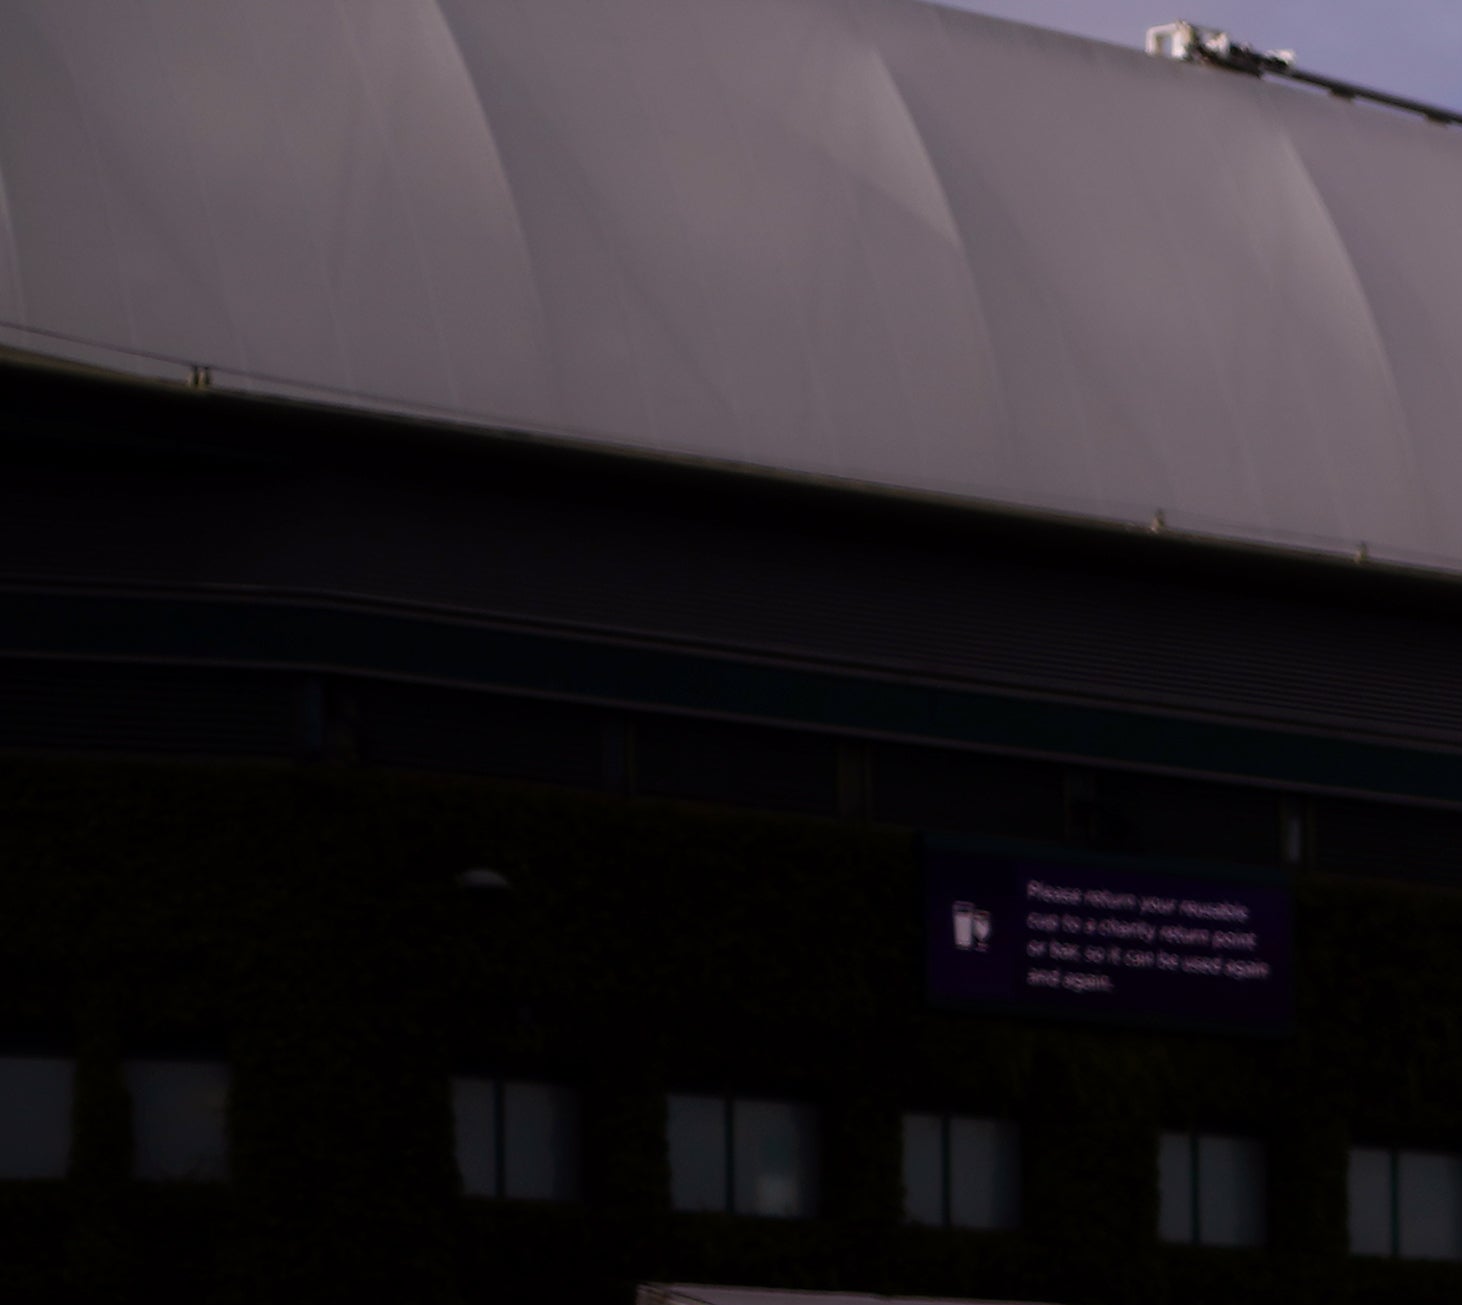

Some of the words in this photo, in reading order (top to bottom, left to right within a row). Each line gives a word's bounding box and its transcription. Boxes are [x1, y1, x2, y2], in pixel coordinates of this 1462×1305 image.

[1026, 879, 1082, 905] Please
[1084, 888, 1136, 910] return
[1138, 896, 1177, 916] your
[1179, 898, 1249, 923] reusable
[1061, 914, 1082, 934] to
[1098, 917, 1155, 944] charity
[1159, 924, 1210, 946] return
[1211, 929, 1257, 951] point
[1026, 938, 1047, 957] or
[1084, 945, 1105, 964] so
[1123, 949, 1155, 968] can
[1156, 949, 1179, 970] be
[1181, 954, 1223, 975] used
[1224, 959, 1272, 981] again
[1026, 966, 1061, 988] and
